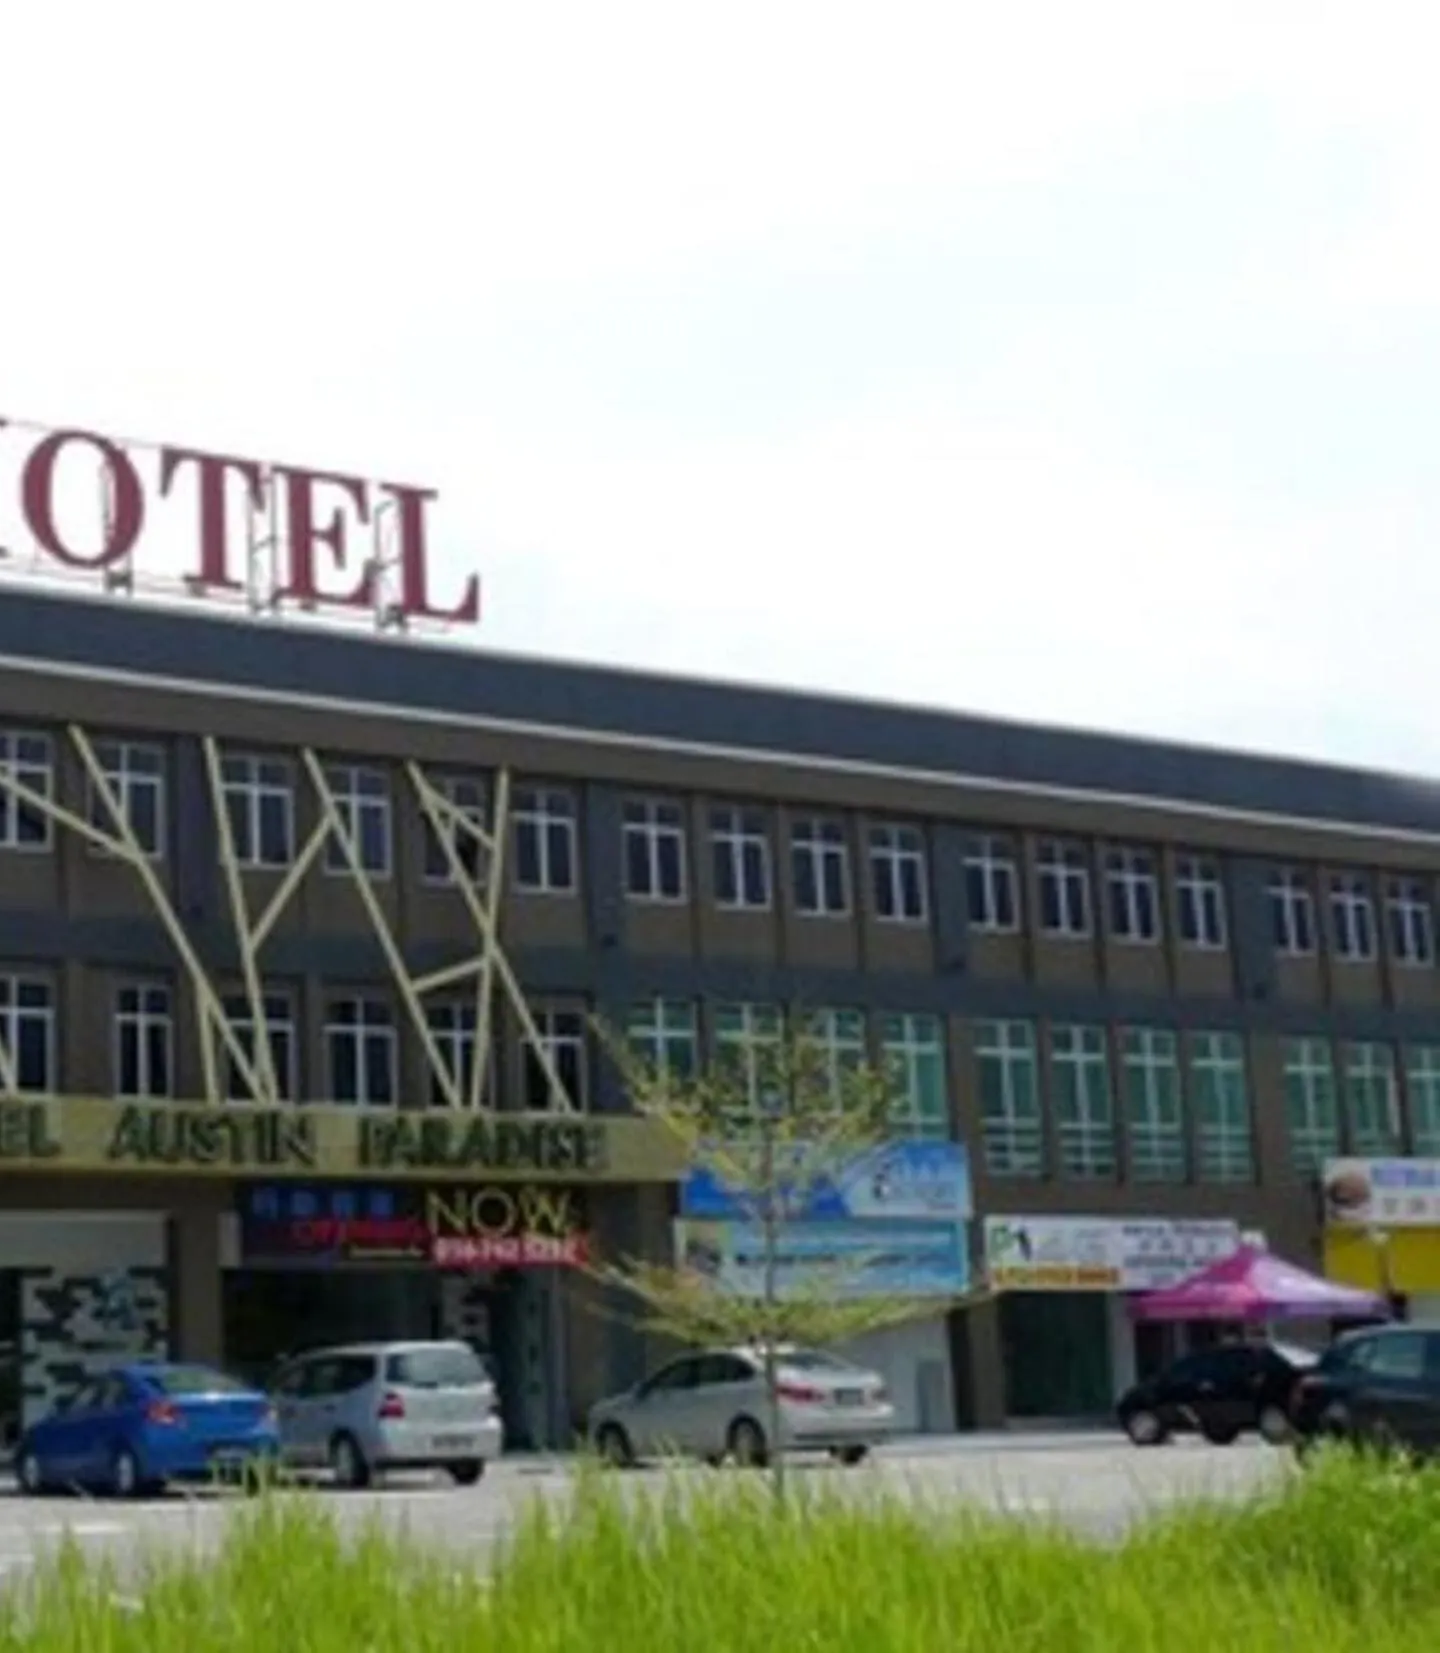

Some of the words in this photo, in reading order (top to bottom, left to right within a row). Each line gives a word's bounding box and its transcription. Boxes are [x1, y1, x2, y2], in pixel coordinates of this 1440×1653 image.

[106, 1103, 317, 1168] AUSTIN
[359, 1114, 608, 1172] PARADISE
[426, 1185, 573, 1236] NOW
